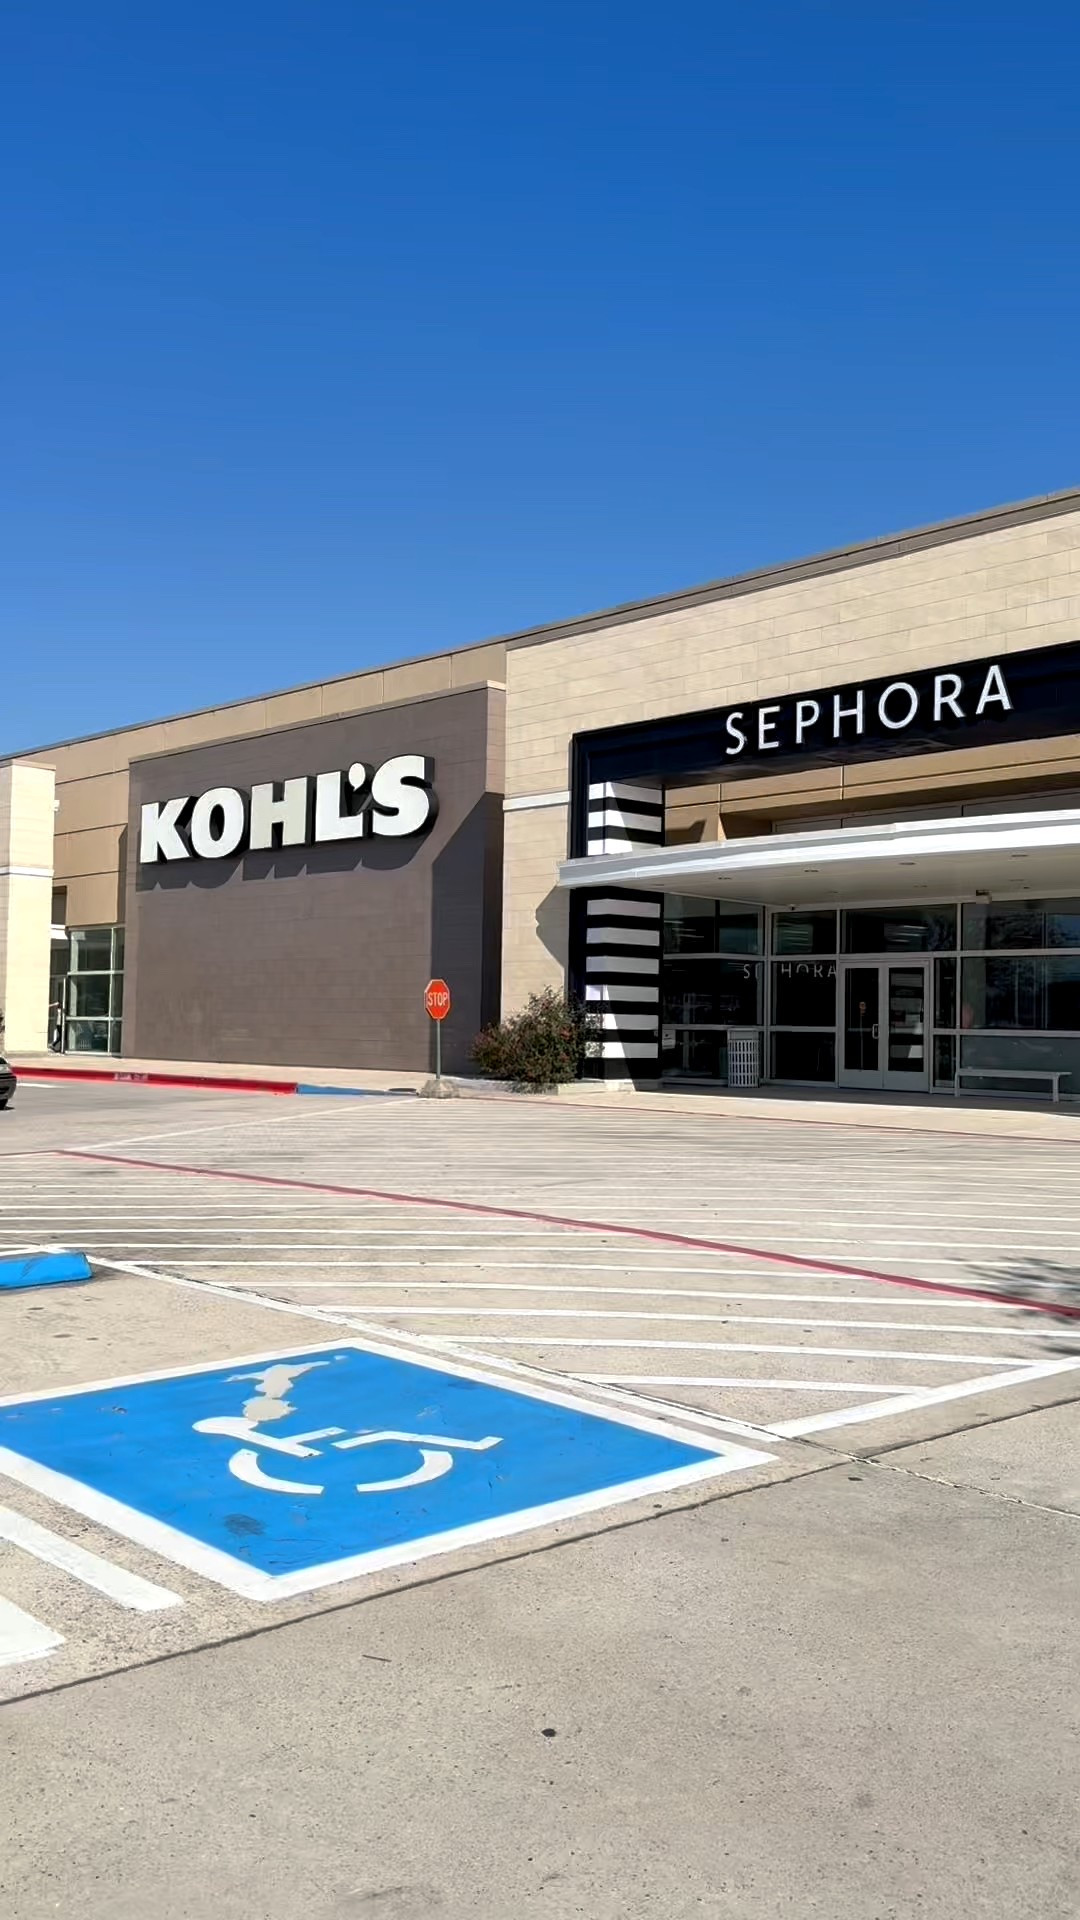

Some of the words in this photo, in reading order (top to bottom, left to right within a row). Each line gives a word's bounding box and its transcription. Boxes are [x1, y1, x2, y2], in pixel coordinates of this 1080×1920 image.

[725, 664, 1012, 755] SEPHORA
[139, 754, 432, 864] KOHL'S
[743, 962, 837, 979] SHORA
[427, 991, 448, 1007] STOP
